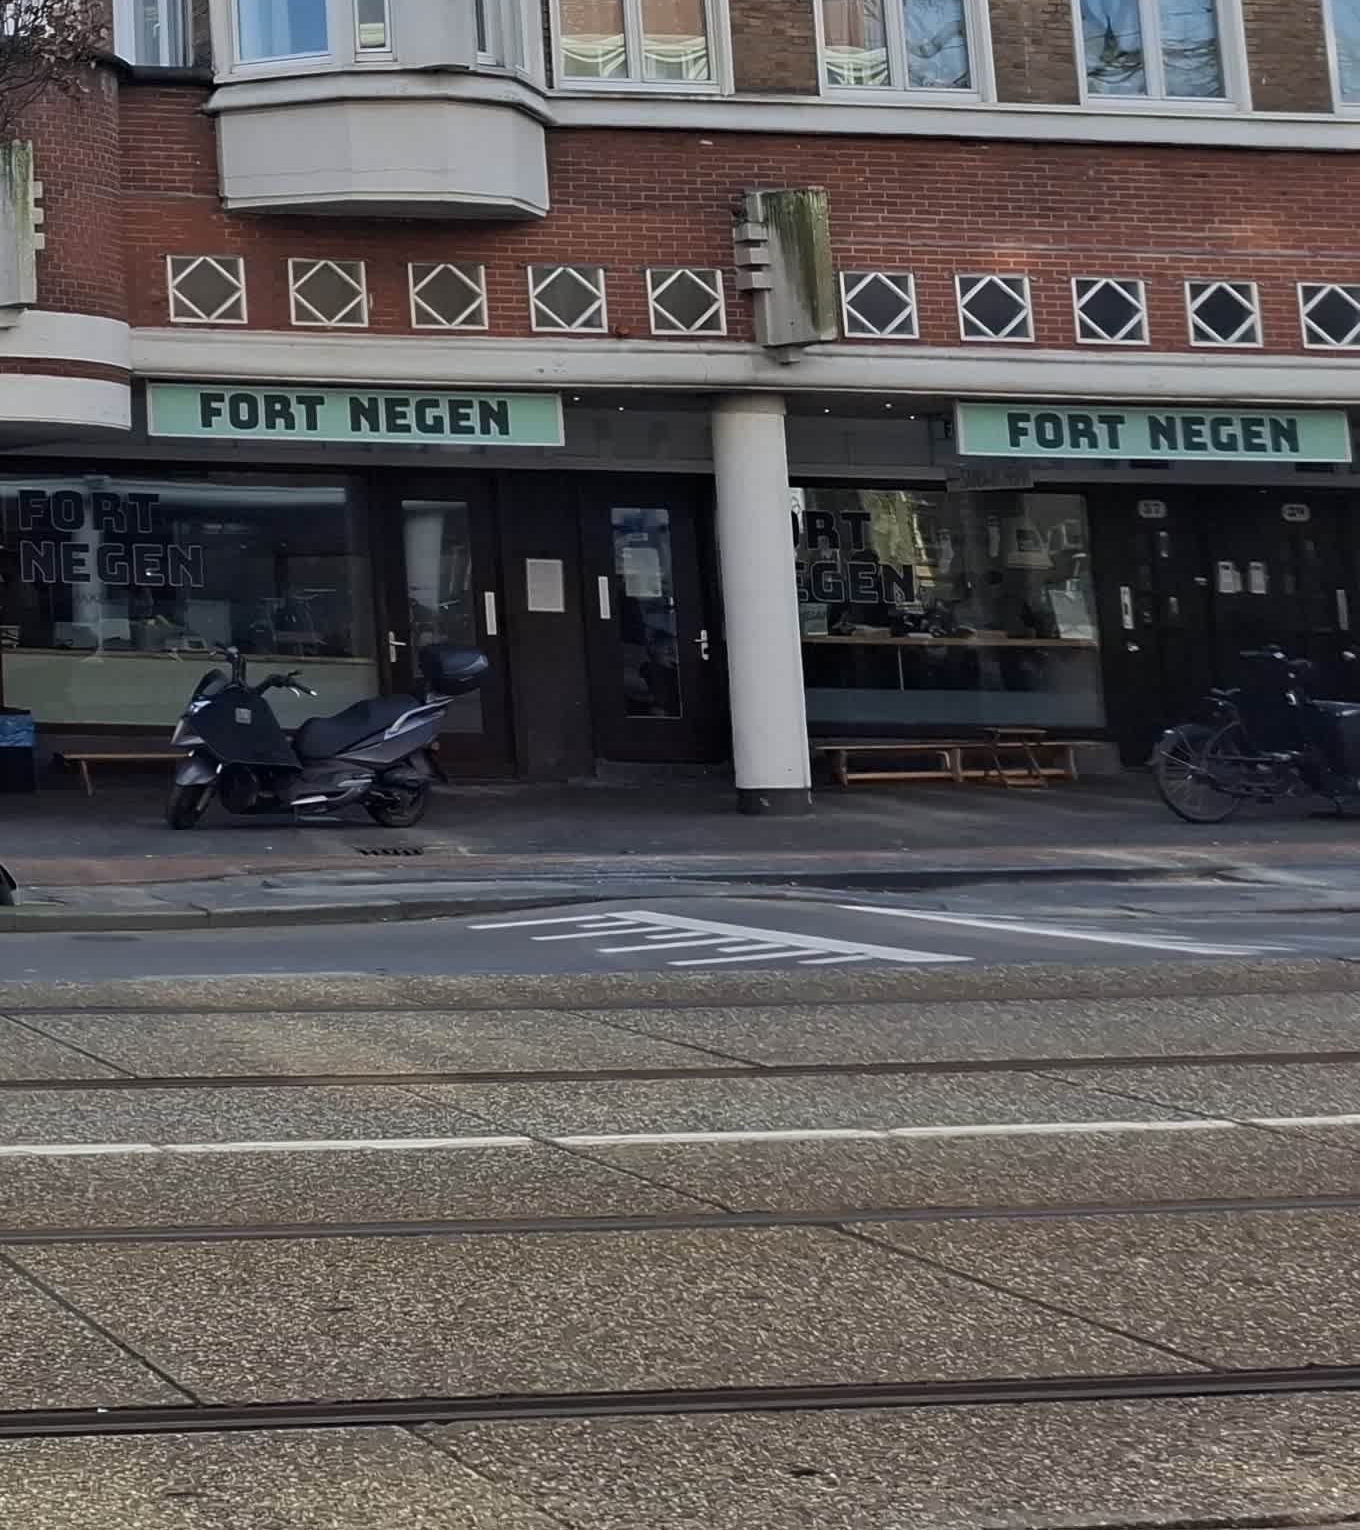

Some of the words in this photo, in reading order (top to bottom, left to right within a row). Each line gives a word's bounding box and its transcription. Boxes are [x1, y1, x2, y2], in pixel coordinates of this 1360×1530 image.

[199, 392, 326, 431] FORT
[348, 395, 510, 435] NEGEN
[1006, 412, 1126, 450] FORT
[1147, 414, 1300, 453] NEGEN
[17, 488, 161, 534] FORT
[791, 509, 872, 552] RT
[19, 539, 205, 588] NEGEN
[795, 560, 918, 605] EGEN
